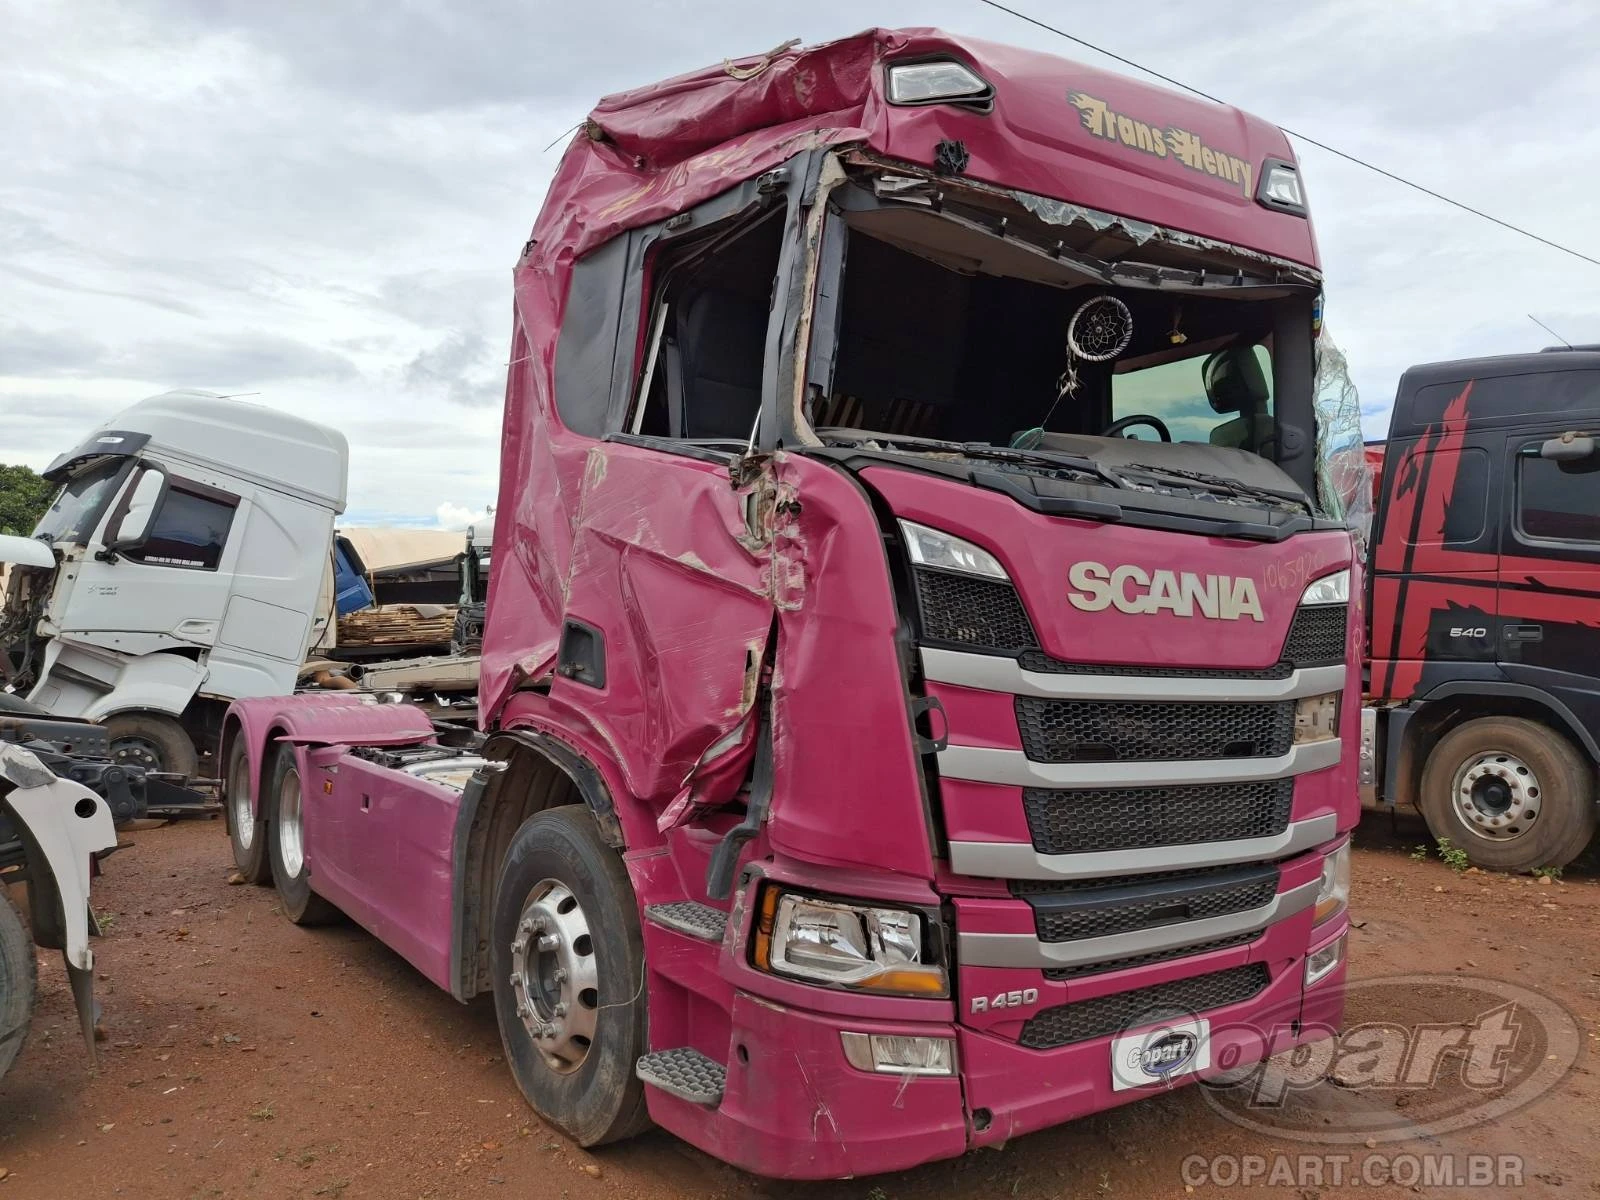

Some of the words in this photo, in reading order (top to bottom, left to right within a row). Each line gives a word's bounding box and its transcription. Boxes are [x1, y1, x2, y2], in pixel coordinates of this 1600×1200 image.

[1067, 92, 1167, 157] Trans
[1167, 127, 1252, 198] Henry
[1067, 561, 1264, 622] SCANIA
[1450, 627, 1487, 638] 540
[971, 997, 988, 1014] R
[991, 988, 1038, 1009] 450
[1127, 1038, 1190, 1069] Copart
